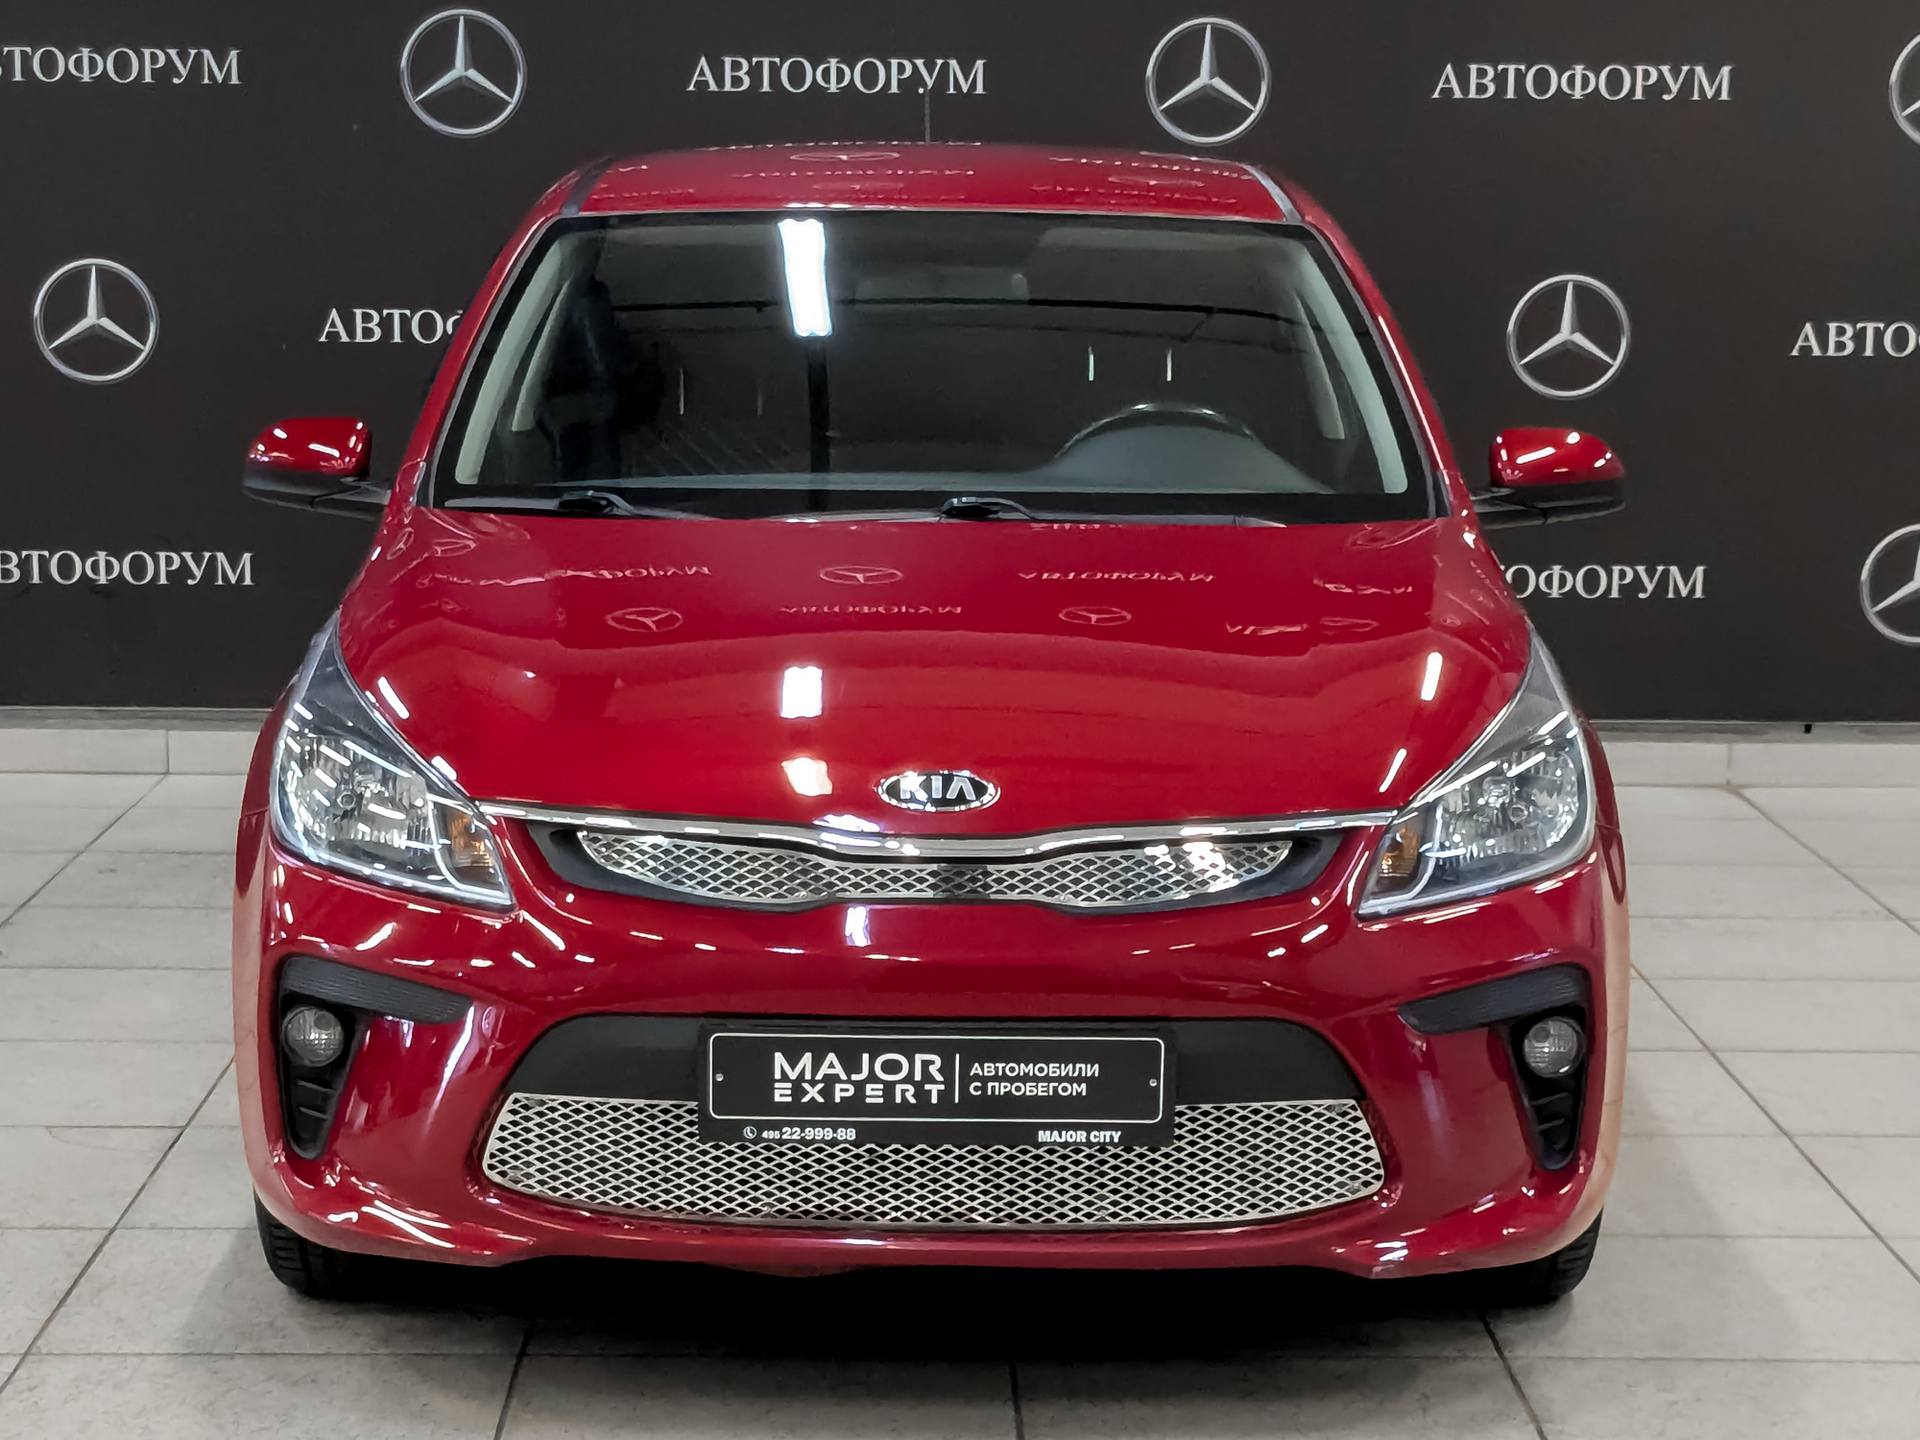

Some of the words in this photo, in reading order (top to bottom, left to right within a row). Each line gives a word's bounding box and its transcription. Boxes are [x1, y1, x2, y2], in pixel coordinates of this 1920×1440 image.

[0, 46, 243, 85] ТОФОРУМ
[685, 54, 988, 95] АВТОФОРУМ
[1430, 62, 1735, 101] АВТОФОРУМ
[1788, 321, 1920, 358] АВТО
[0, 550, 255, 586] ВТОФОРУМ
[1500, 564, 1707, 599] ОФОРУМ
[900, 774, 976, 802] KIA
[774, 1052, 945, 1082] MAJOR
[969, 1062, 1100, 1078] АВТОМОБИЛИ
[773, 1082, 946, 1105] EXPERT
[969, 1081, 982, 1096] С
[987, 1082, 1087, 1097] ПРОБЕГОМ
[781, 1126, 857, 1141] 22-999-88
[1037, 1129, 1087, 1143] MAJOR
[1089, 1130, 1122, 1144] CITY
